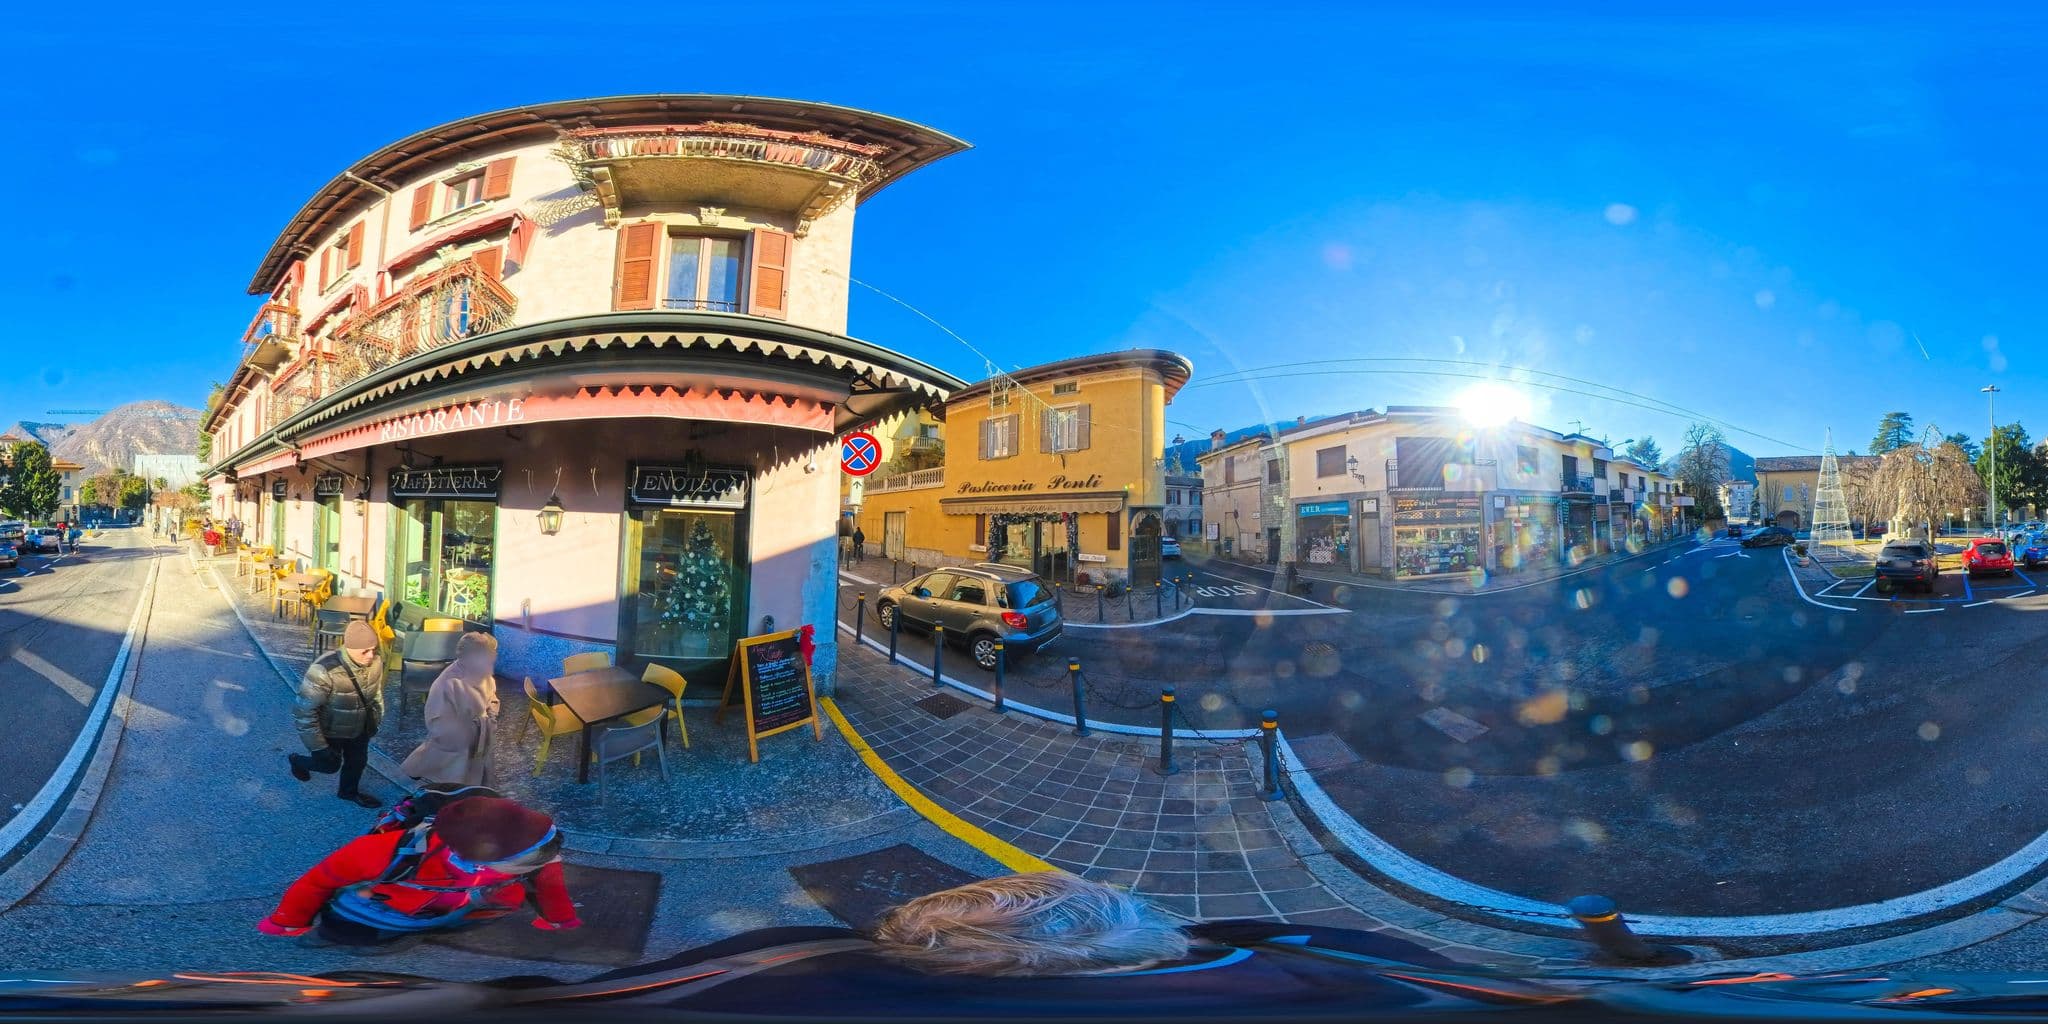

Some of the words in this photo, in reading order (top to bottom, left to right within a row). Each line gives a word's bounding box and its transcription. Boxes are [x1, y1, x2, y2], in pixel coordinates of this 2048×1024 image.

[380, 398, 525, 442] RISTORANTE
[643, 475, 738, 494] ENOTECA
[958, 480, 1034, 493] Pasticceria
[1048, 474, 1102, 489] Ponti
[1196, 585, 1257, 597] STOP
